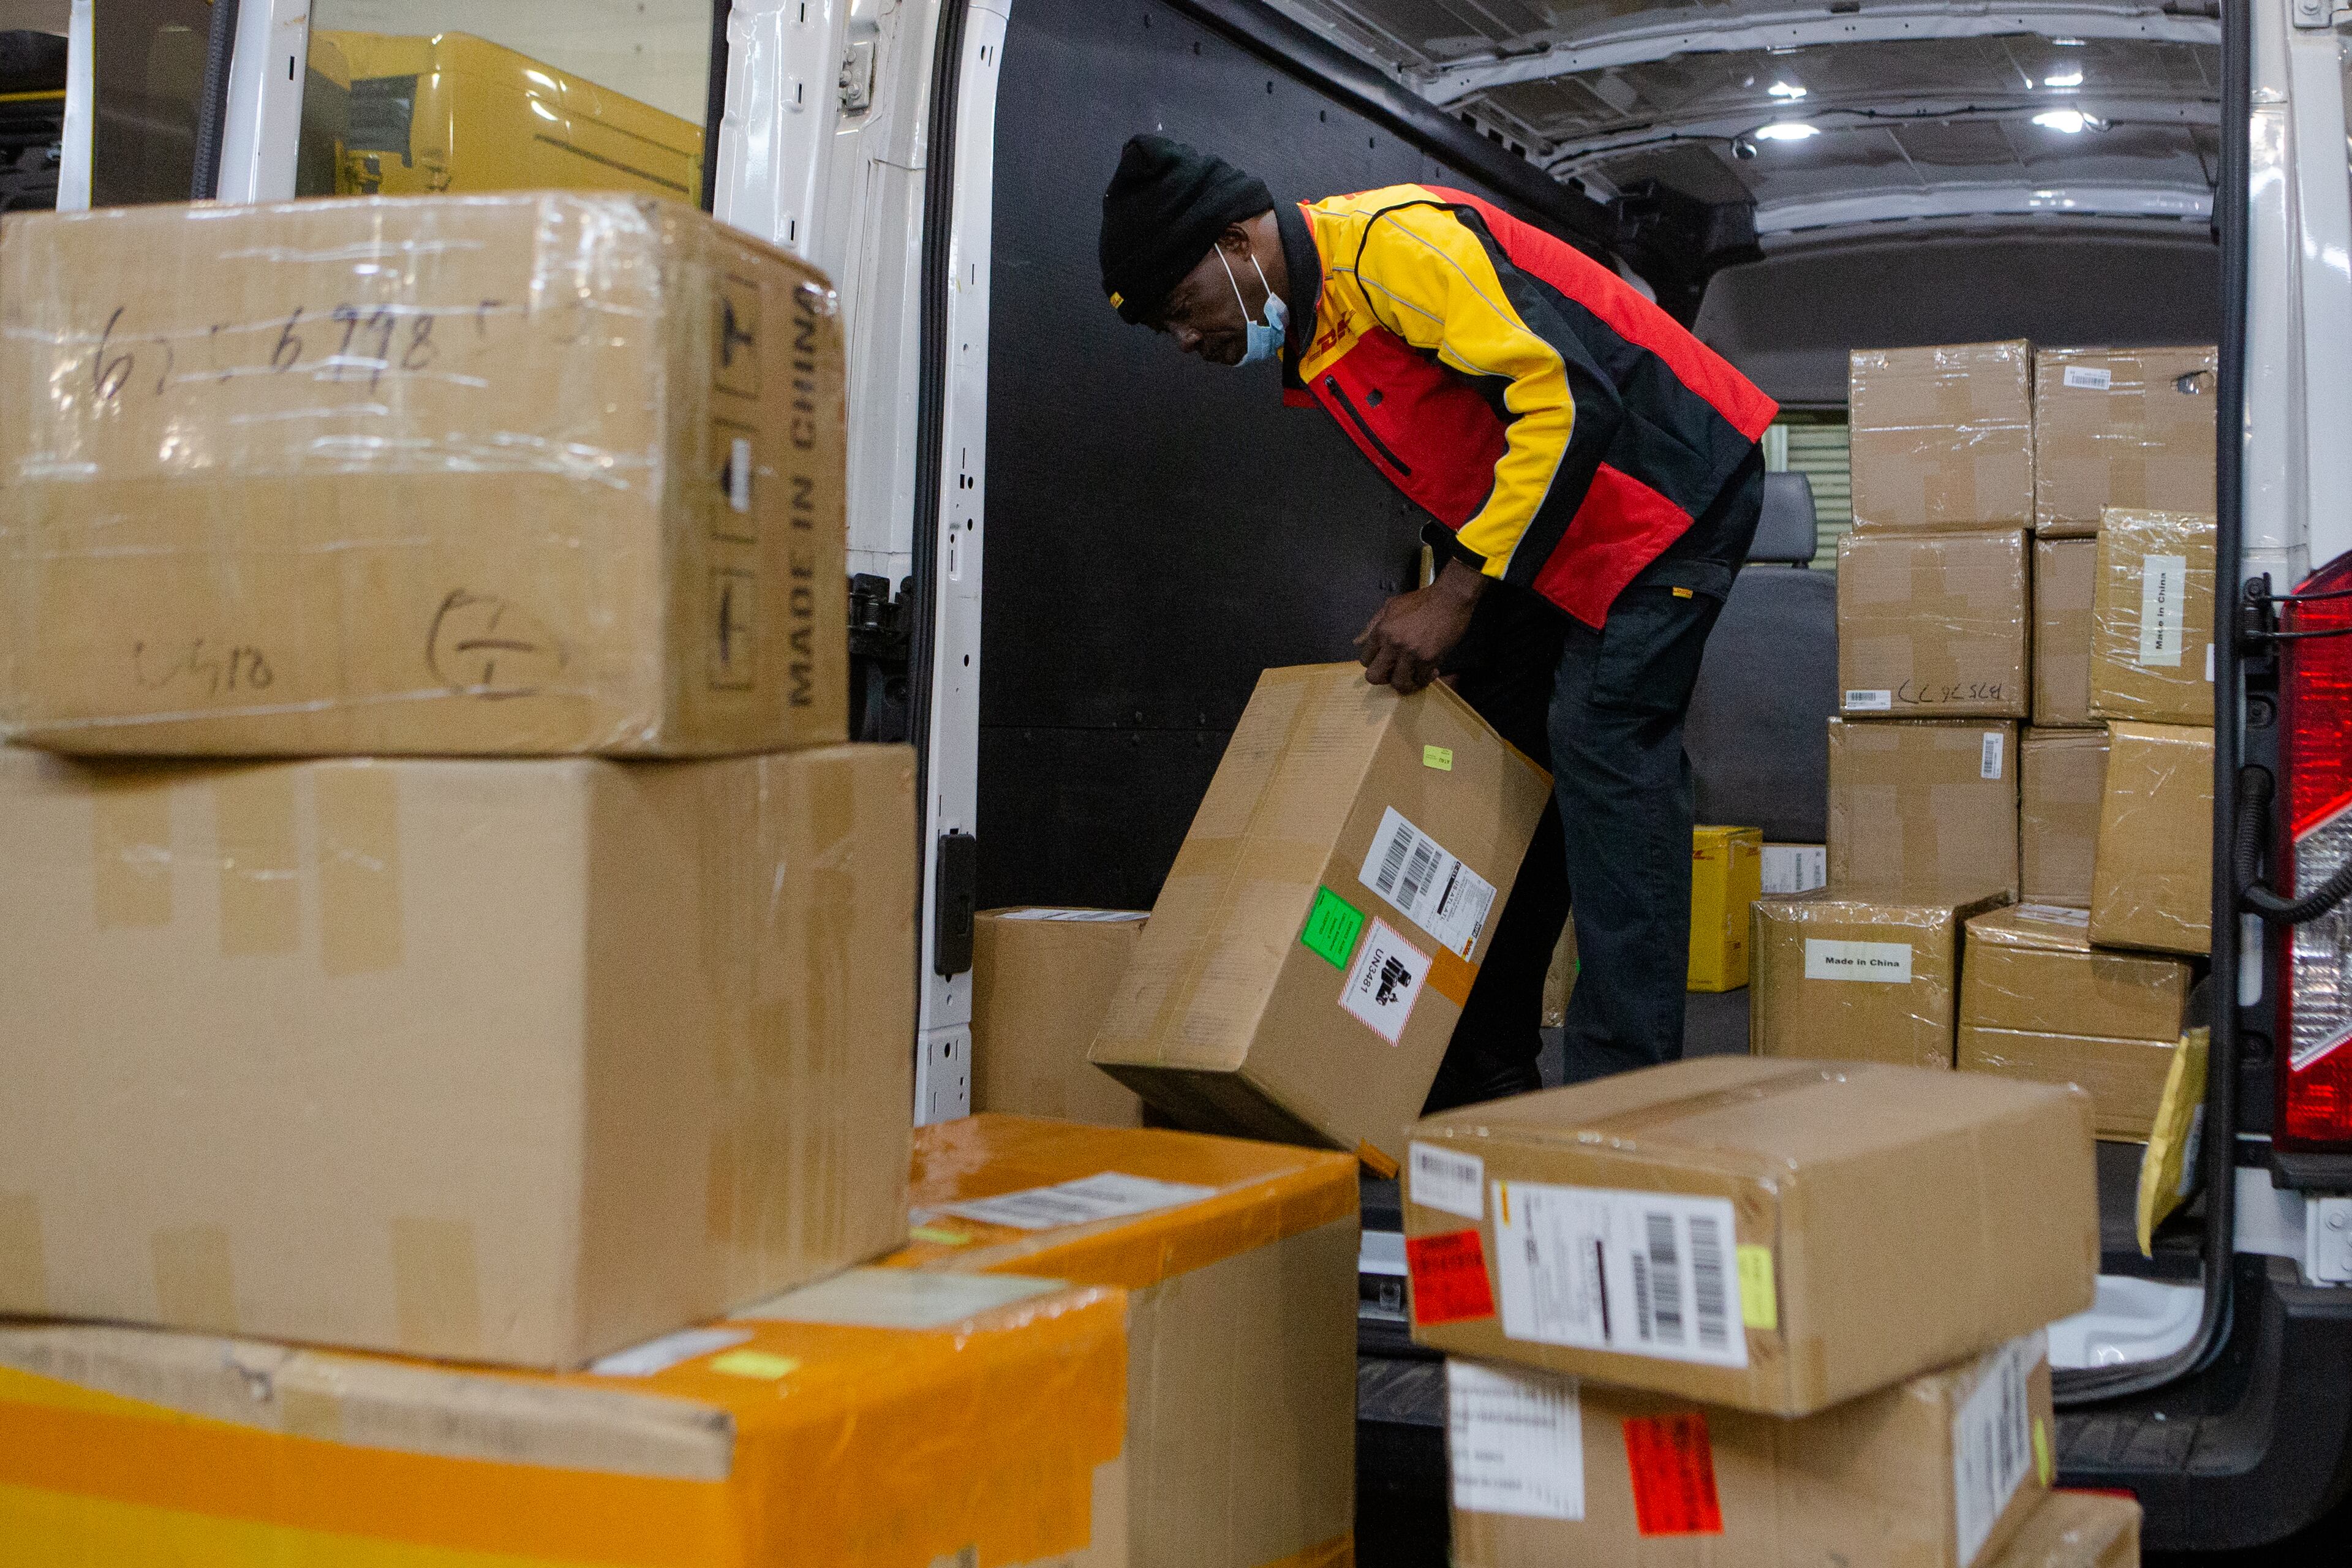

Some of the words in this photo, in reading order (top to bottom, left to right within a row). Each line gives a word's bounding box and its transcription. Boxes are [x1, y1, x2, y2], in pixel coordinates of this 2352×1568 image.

[791, 475, 813, 530] IN
[2158, 573, 2166, 603] China
[790, 550, 813, 707] MADE
[2157, 607, 2165, 617] in
[1361, 948, 1384, 993] UN3481
